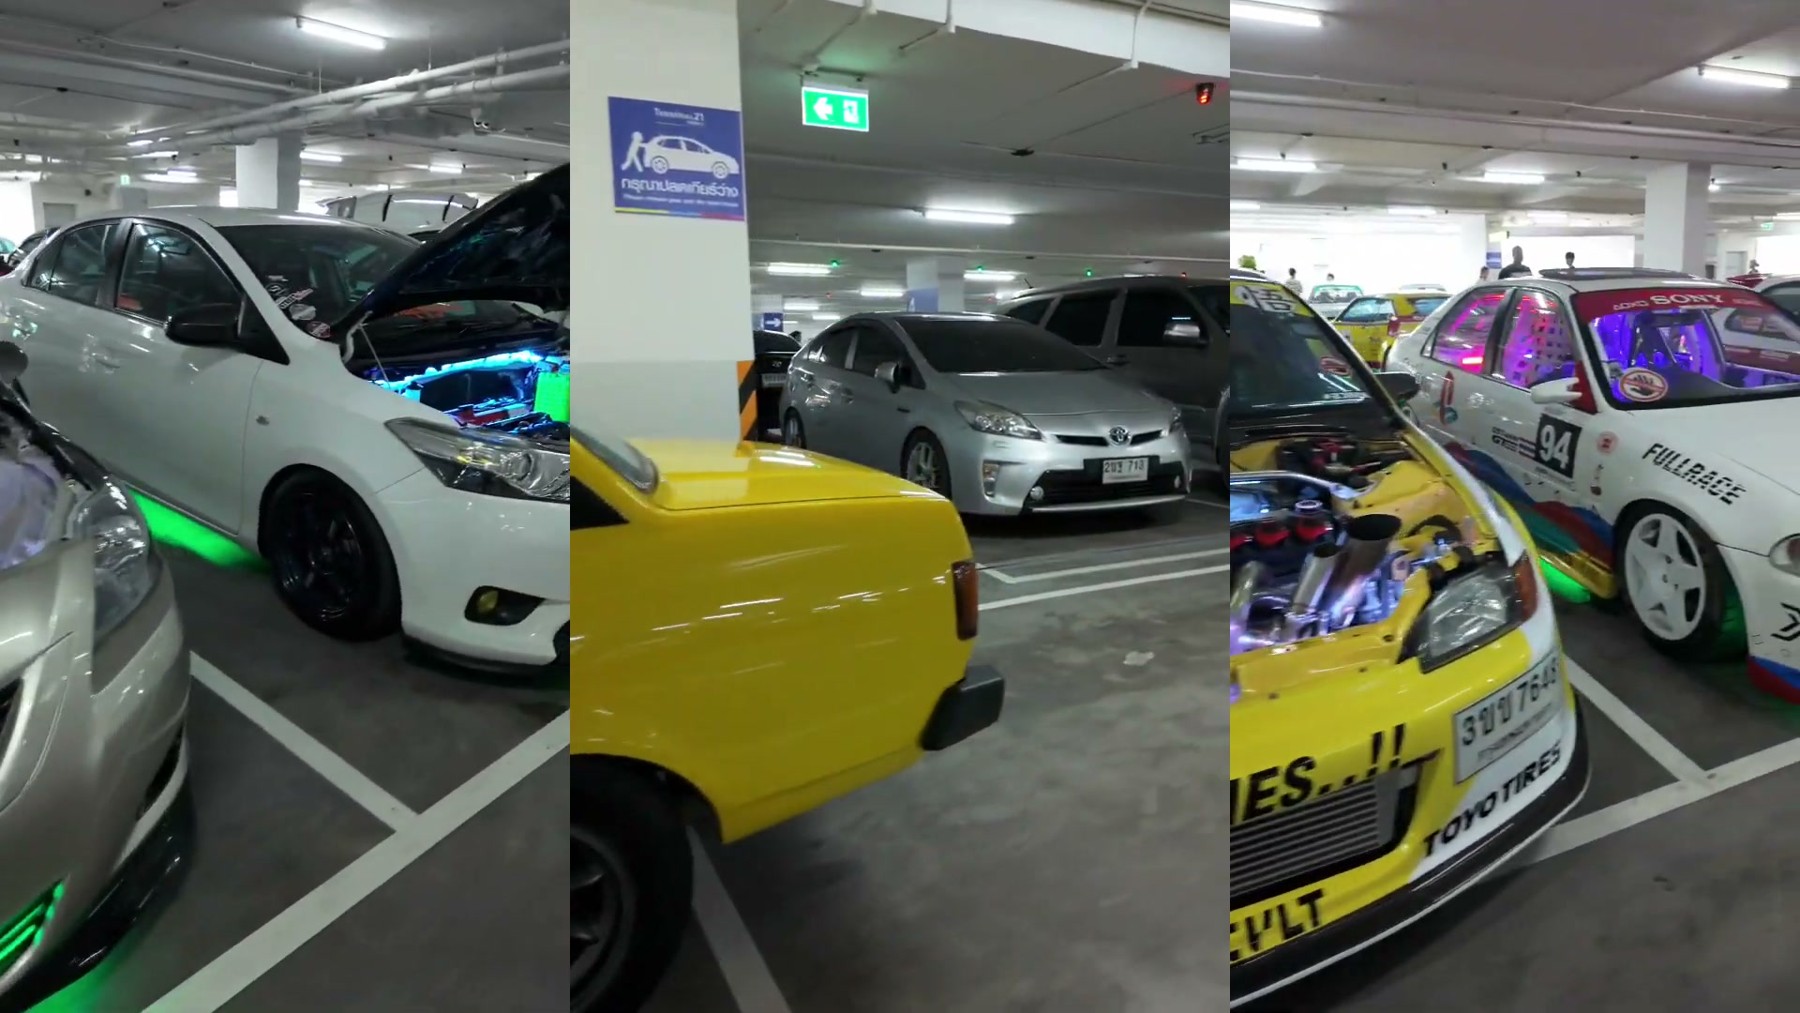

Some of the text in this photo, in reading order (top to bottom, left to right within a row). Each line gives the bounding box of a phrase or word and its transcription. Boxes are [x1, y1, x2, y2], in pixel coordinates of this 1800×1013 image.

[1650, 293, 1726, 305] SONY
[1539, 424, 1572, 470] 94
[1641, 442, 1747, 506] FULLRACE
[1423, 739, 1561, 857] TOYO TIRES
